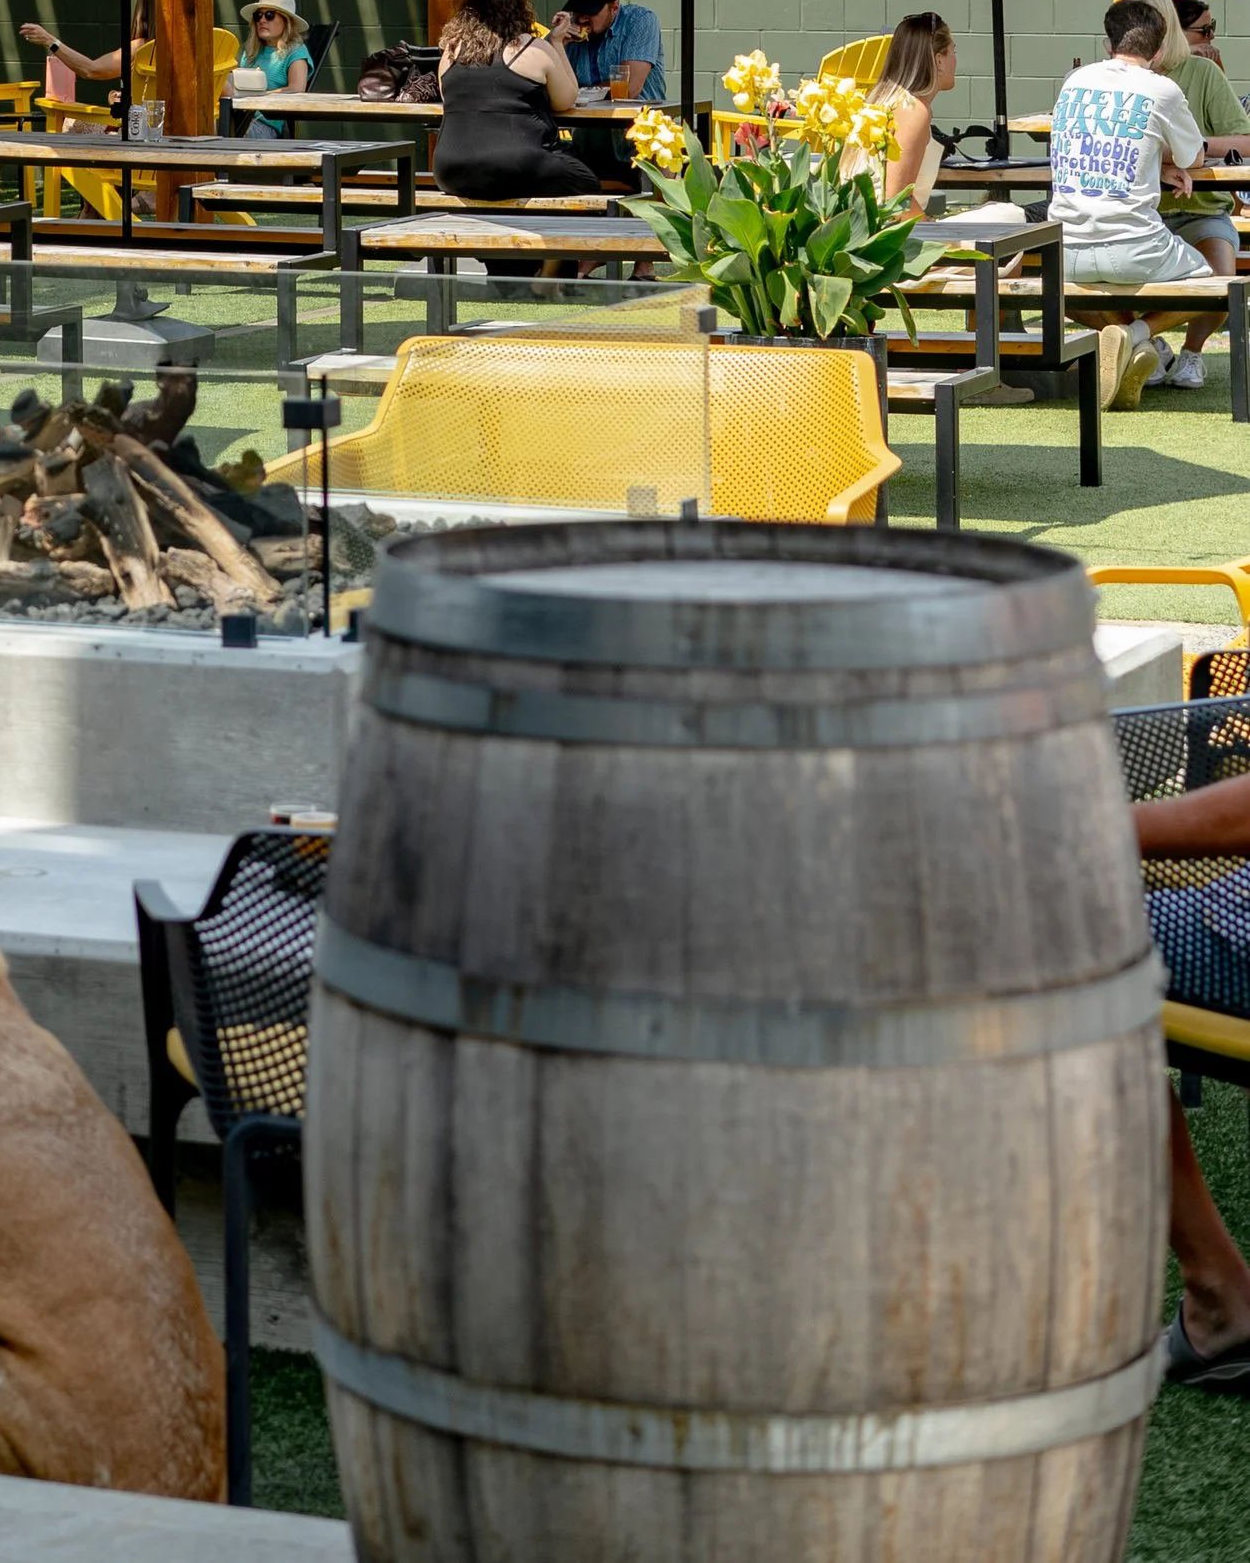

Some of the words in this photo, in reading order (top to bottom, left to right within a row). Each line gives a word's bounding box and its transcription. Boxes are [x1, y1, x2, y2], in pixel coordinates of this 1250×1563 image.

[1056, 102, 1149, 130] MILLER
[1059, 87, 1155, 117] STEVE
[130, 111, 141, 136] Coke
[1052, 117, 1145, 140] BAND
[1079, 132, 1140, 165] Doobie
[1051, 147, 1136, 183] Brothers
